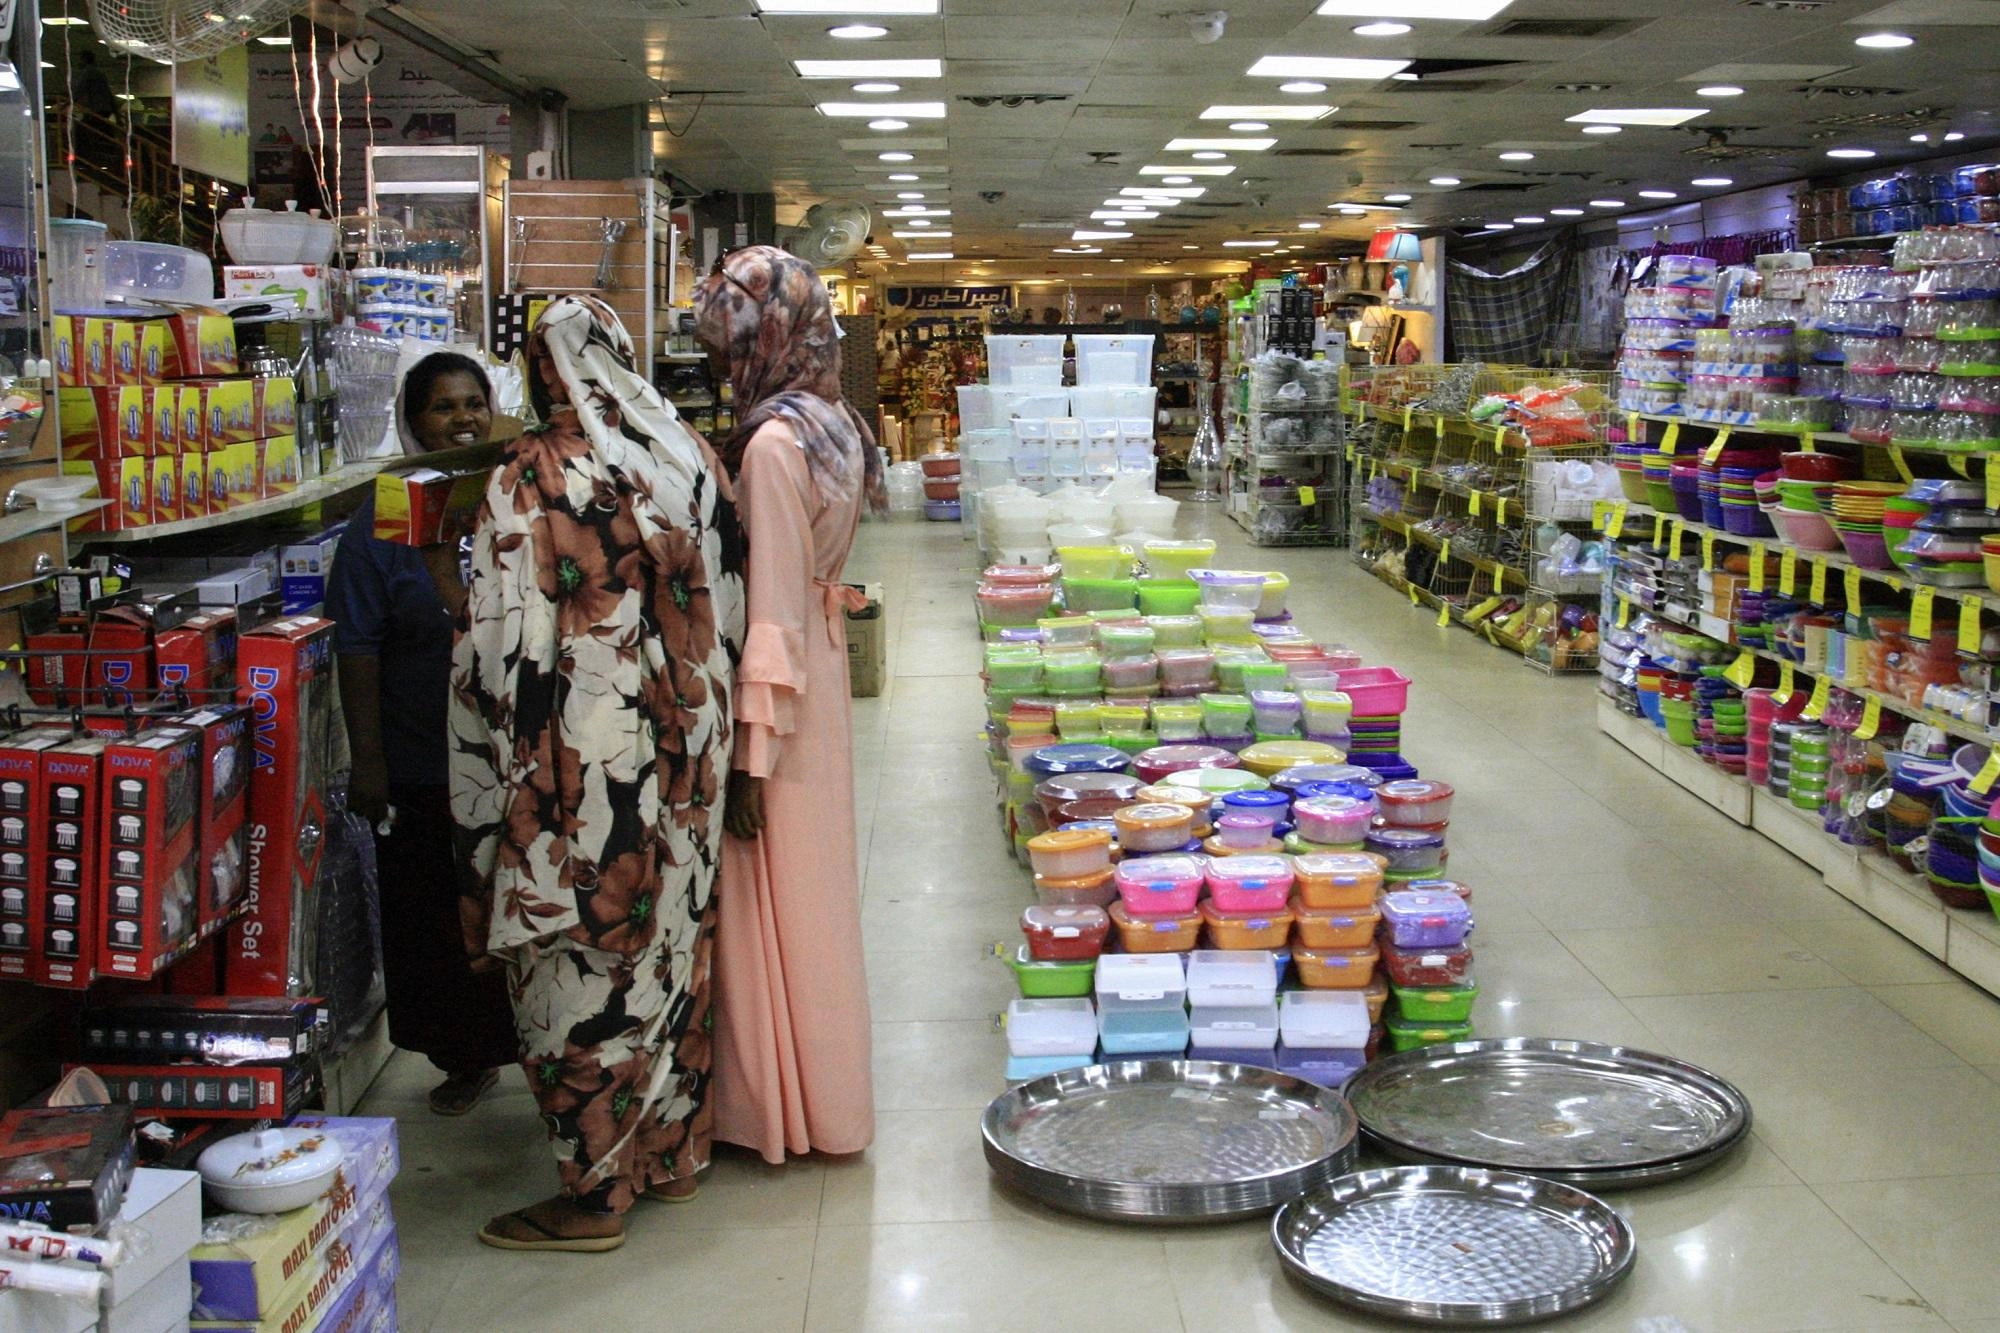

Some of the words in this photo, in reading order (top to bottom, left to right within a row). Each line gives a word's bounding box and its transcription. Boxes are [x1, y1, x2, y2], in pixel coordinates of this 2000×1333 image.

[216, 718, 245, 741] DOVA
[247, 667, 279, 769] DOVA
[48, 762, 89, 777] DOVA
[111, 755, 152, 769] DOVA
[169, 741, 197, 765] DOVA
[248, 824, 267, 914] Shower
[241, 920, 263, 959] Set
[281, 1238, 307, 1281] MAXI
[308, 1203, 339, 1252] BANYO
[281, 1298, 307, 1333] MAXI
[307, 1265, 338, 1313] BANYO
